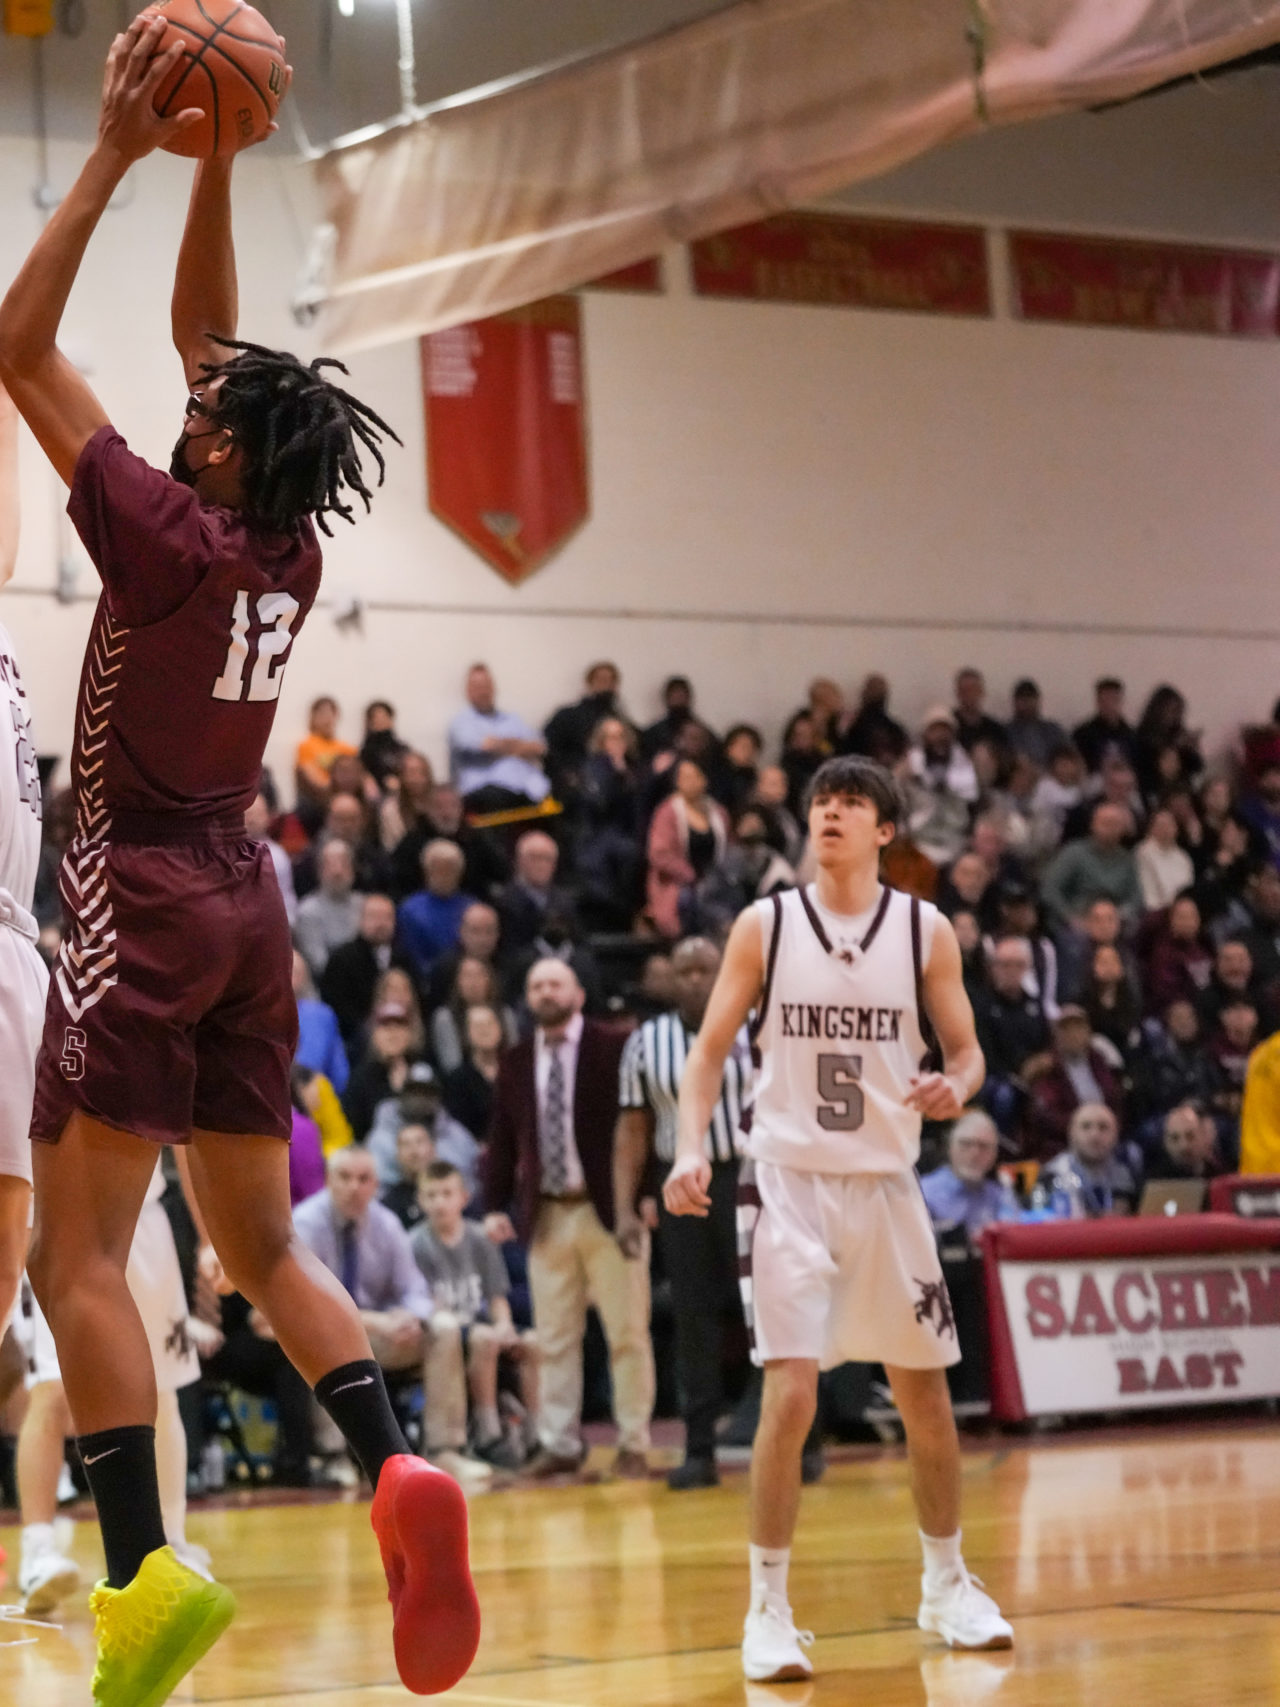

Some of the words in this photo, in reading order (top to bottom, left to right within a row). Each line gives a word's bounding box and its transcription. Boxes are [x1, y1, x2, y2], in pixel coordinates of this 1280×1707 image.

[211, 589, 300, 701] 12
[781, 1003, 903, 1042] KINGSMEN
[60, 1026, 87, 1080] S
[816, 1053, 864, 1131] 5
[1116, 1351, 1244, 1394] EAST
